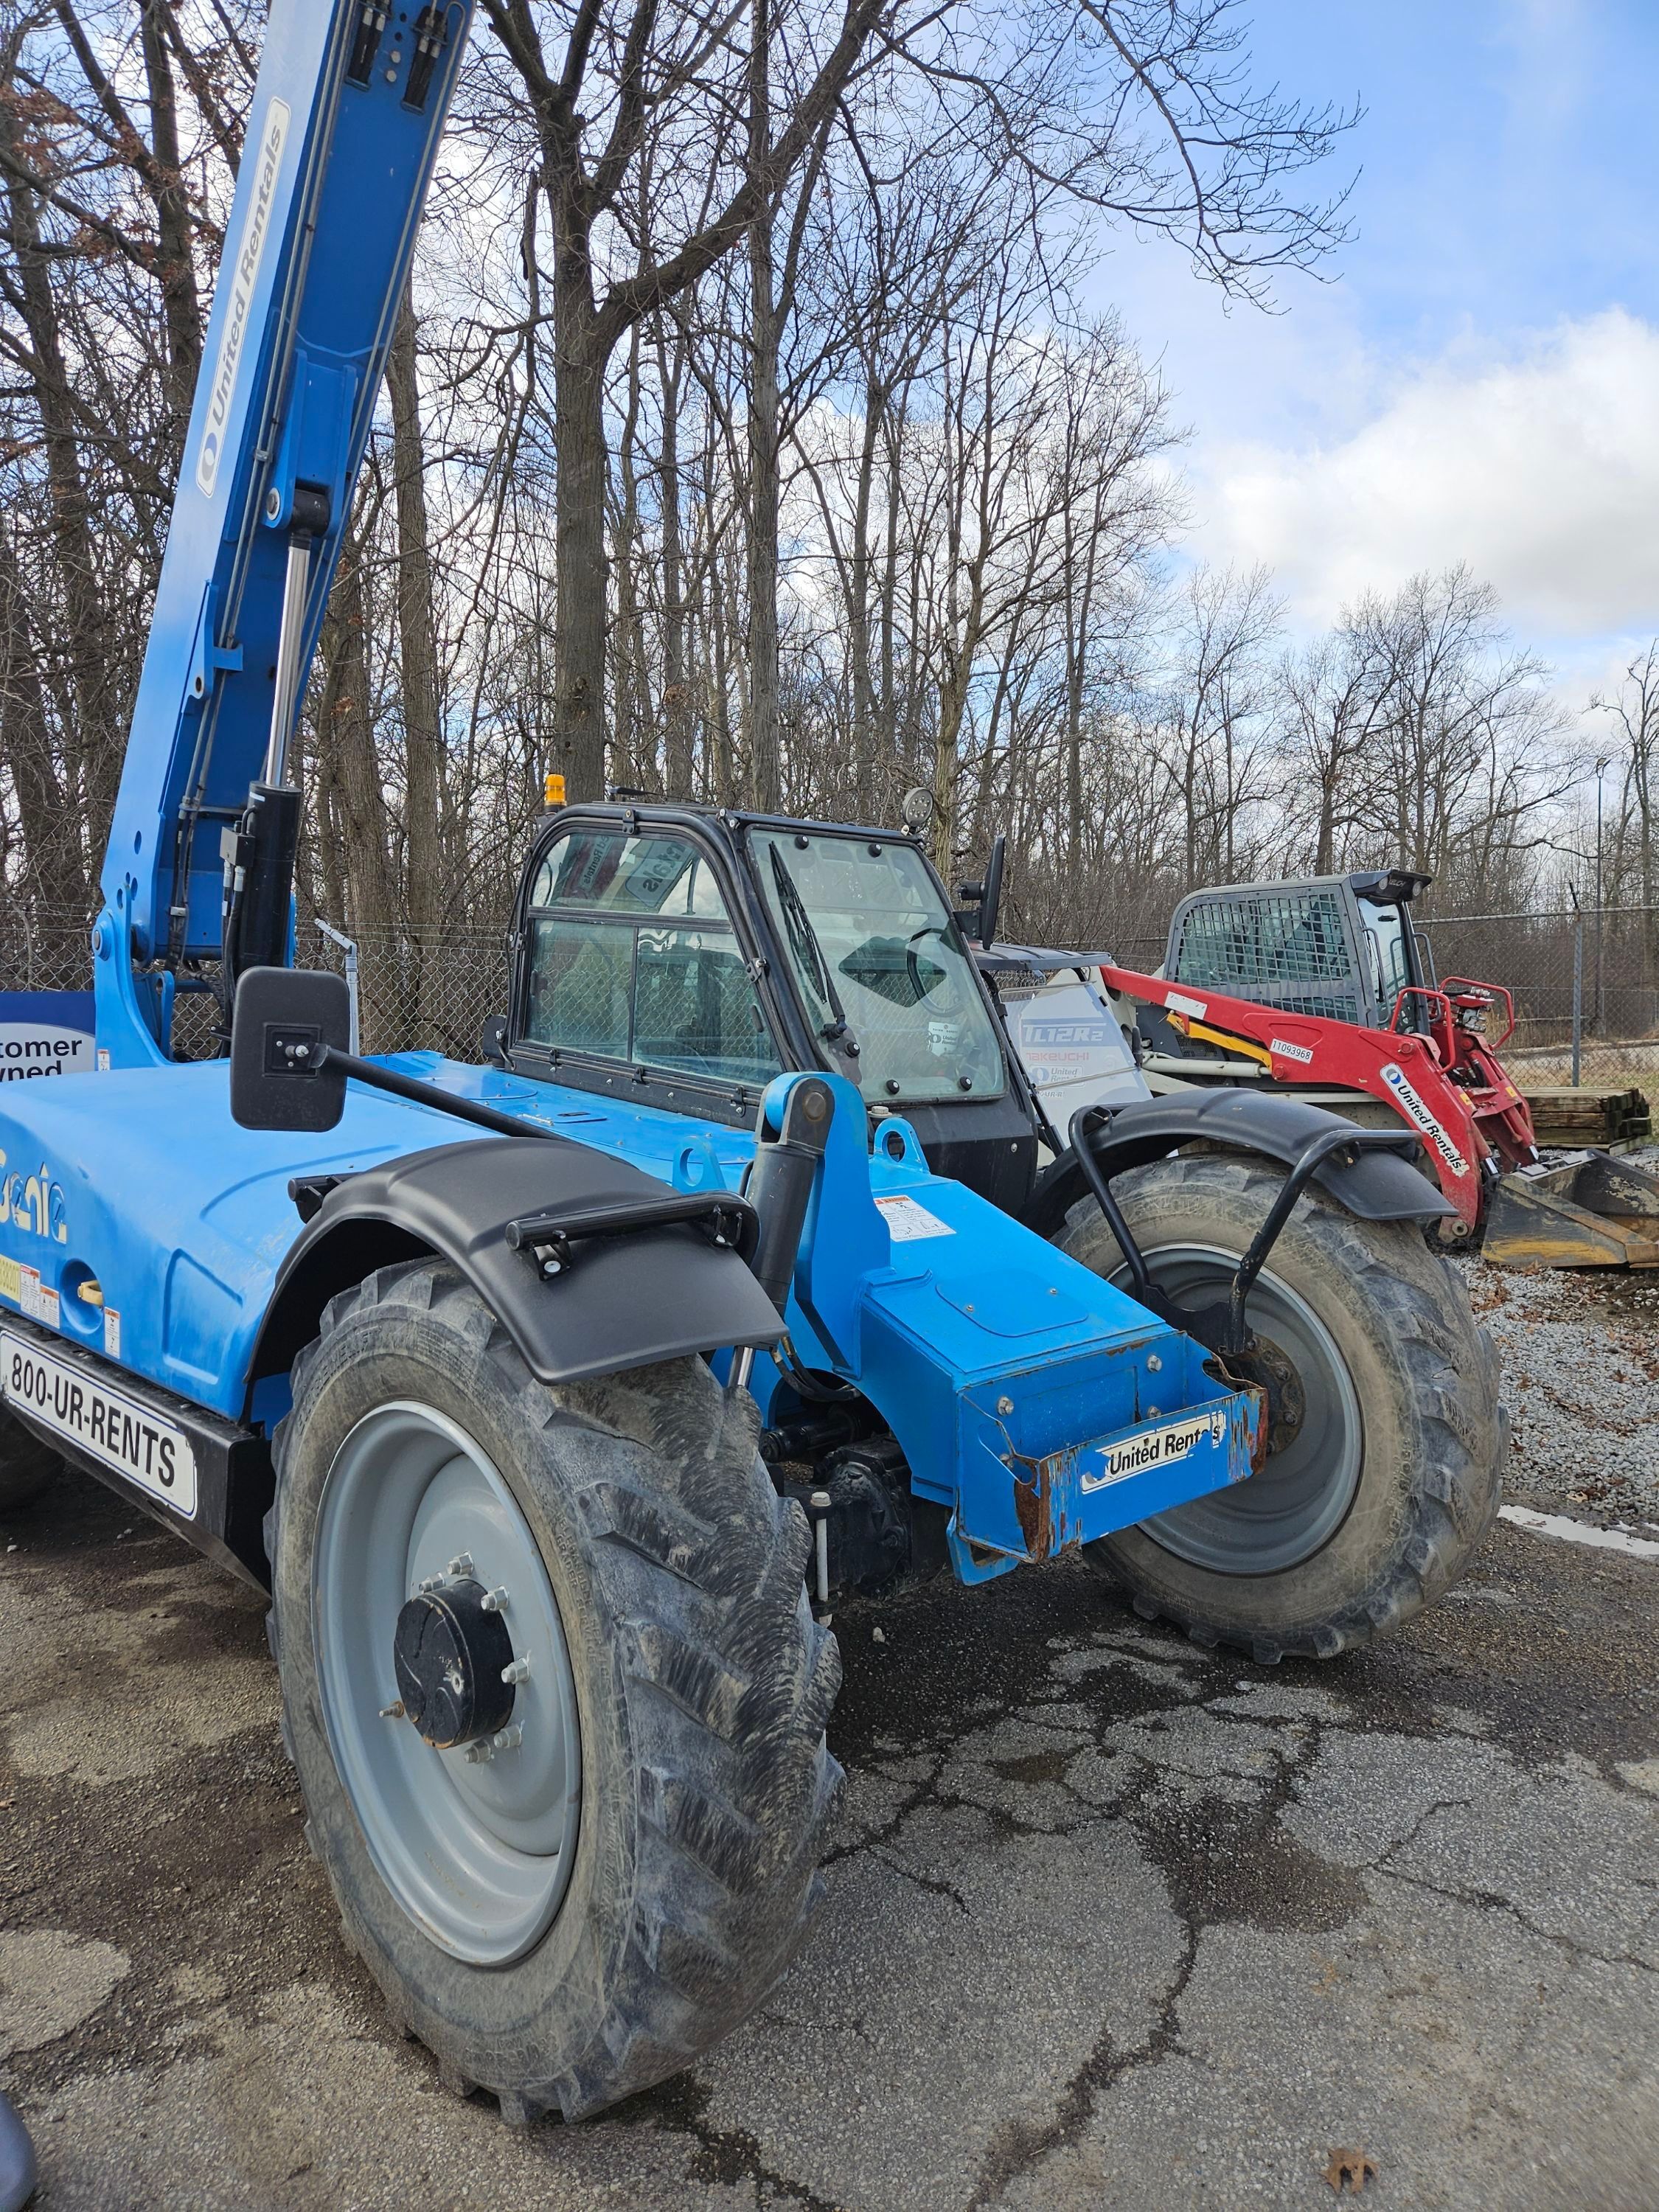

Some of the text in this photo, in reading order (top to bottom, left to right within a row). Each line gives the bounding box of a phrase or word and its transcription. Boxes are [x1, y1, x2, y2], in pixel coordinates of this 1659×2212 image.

[212, 125, 281, 426] United Rentals
[1273, 1040, 1311, 1060] 11093968
[1397, 1085, 1462, 1169] United Rentals
[12, 1352, 175, 1487] 800-UR-RENTS
[1110, 1437, 1161, 1475] United
